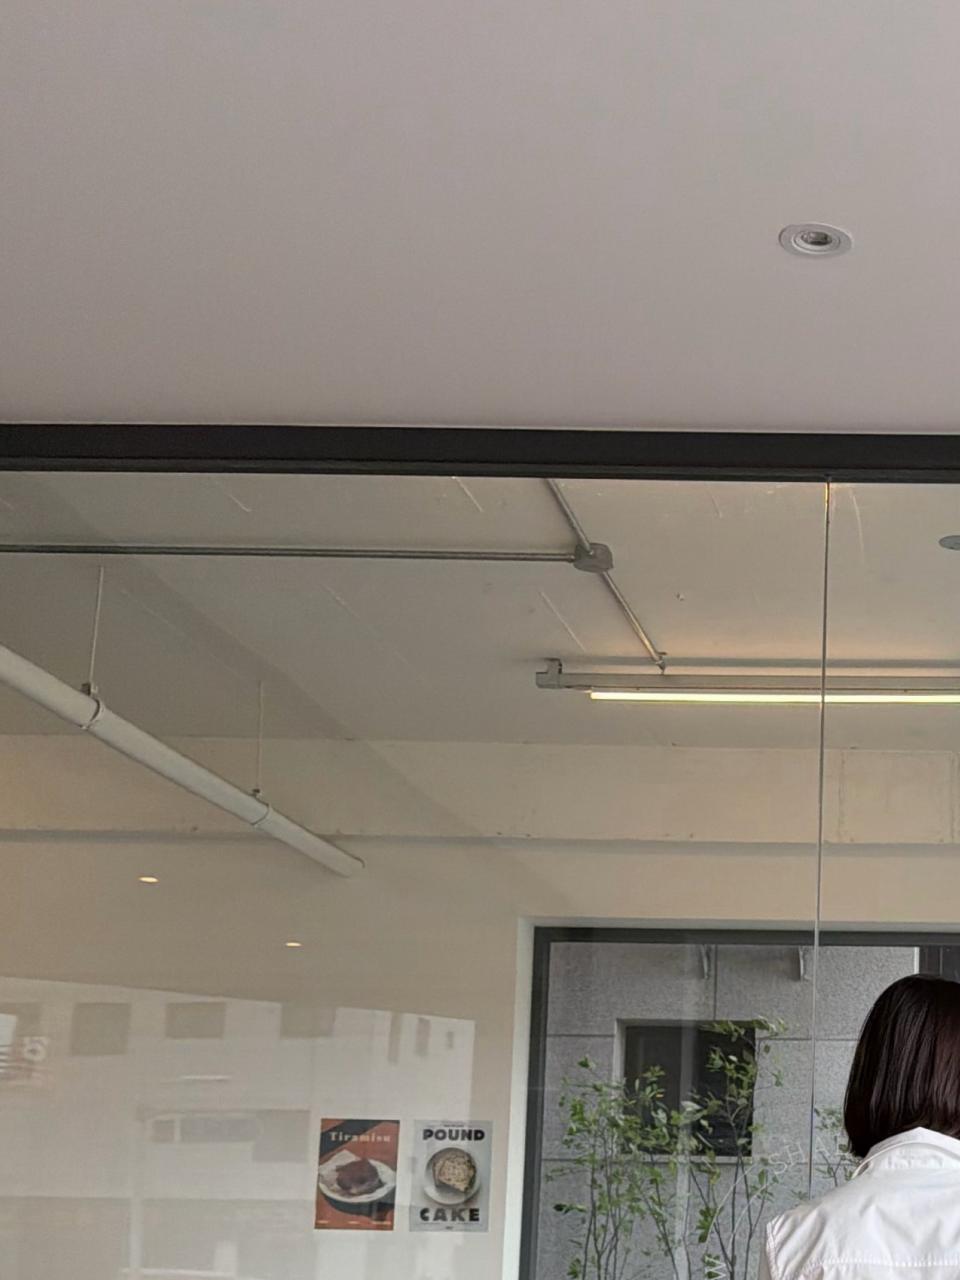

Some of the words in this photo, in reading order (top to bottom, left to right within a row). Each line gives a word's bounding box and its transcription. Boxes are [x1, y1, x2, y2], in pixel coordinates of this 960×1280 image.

[329, 1131, 391, 1143] Tiramisu
[422, 1128, 485, 1141] POUND
[768, 1133, 850, 1176] SHAL
[420, 1207, 480, 1222] CAKE
